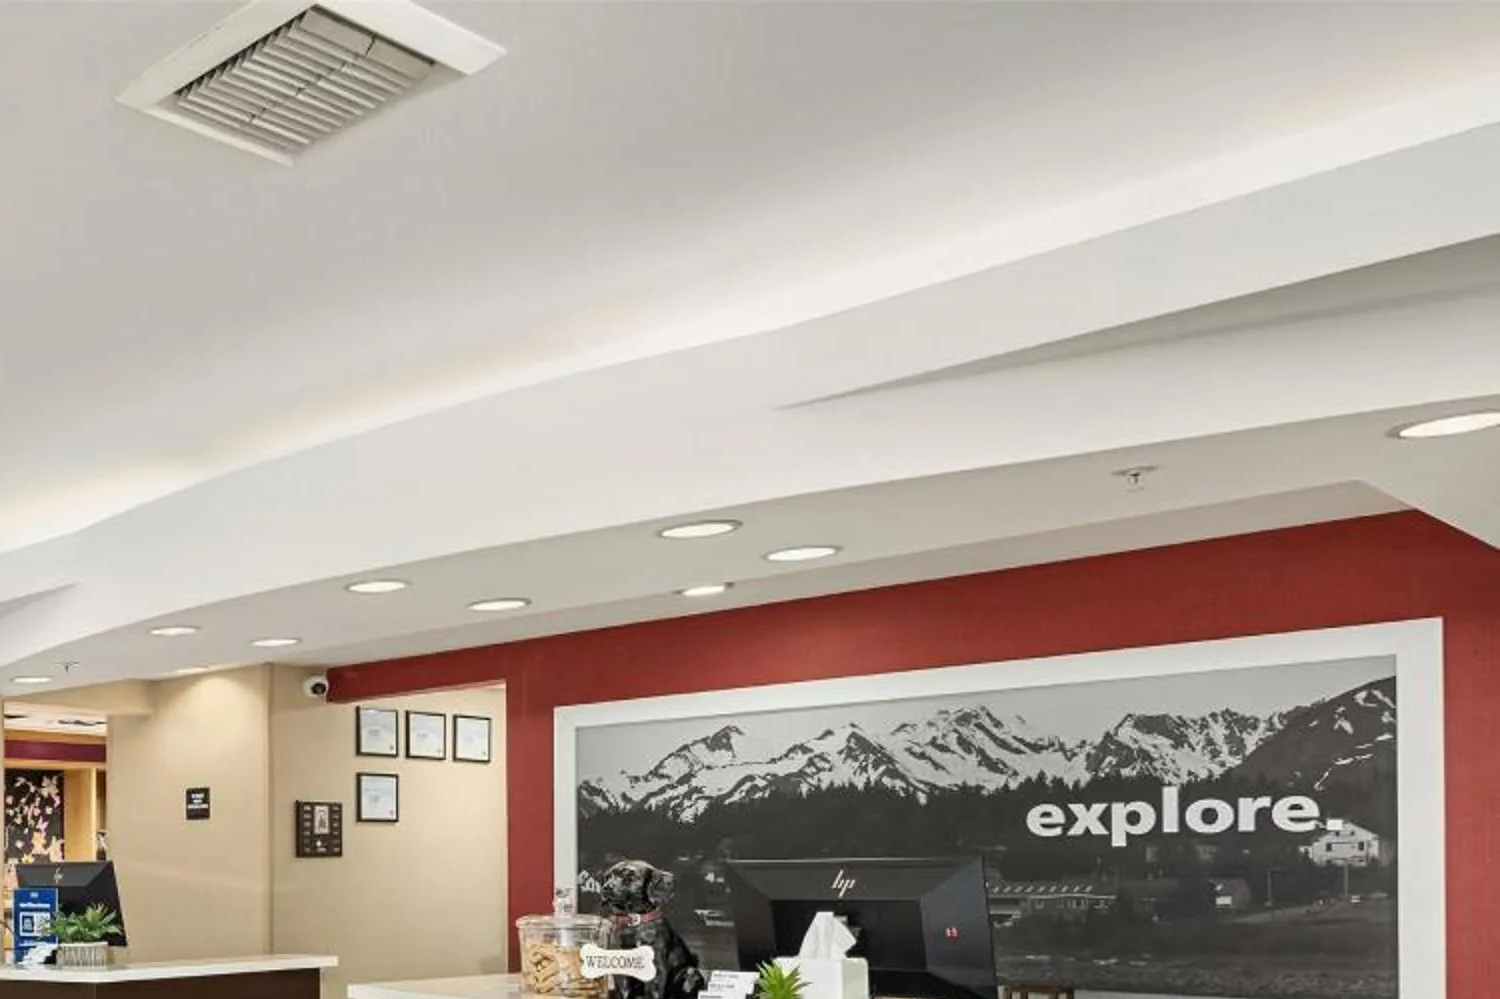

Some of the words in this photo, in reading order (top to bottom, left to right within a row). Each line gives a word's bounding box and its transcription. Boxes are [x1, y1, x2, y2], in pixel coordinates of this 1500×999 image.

[1026, 786, 1344, 847] explore.
[831, 869, 856, 898] hp
[585, 955, 645, 970] WELCOME
